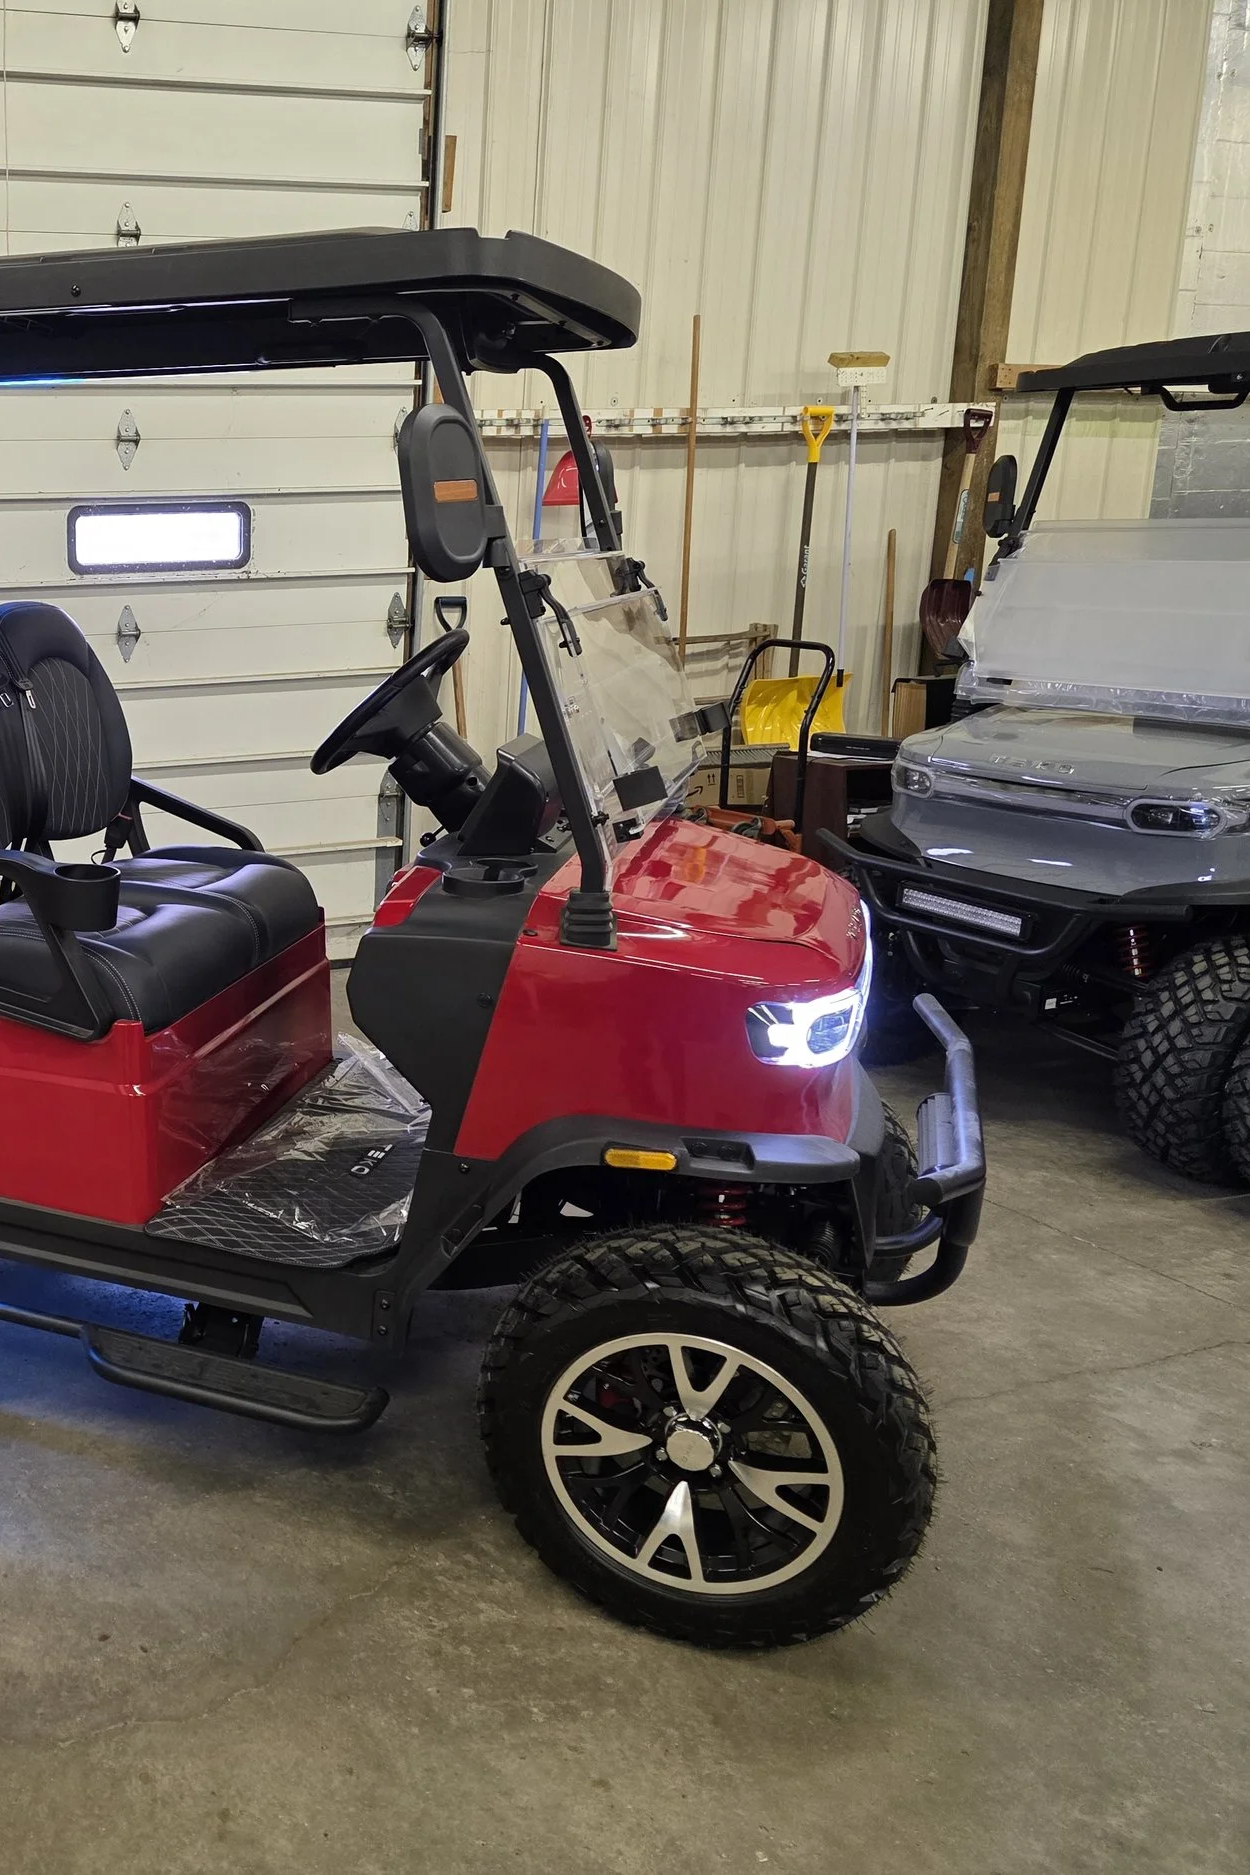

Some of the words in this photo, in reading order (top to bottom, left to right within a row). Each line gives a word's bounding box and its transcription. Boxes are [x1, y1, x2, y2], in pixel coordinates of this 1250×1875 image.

[801, 544, 810, 575] Garant
[989, 753, 1075, 775] TEKO
[350, 1144, 393, 1175] TEKO
